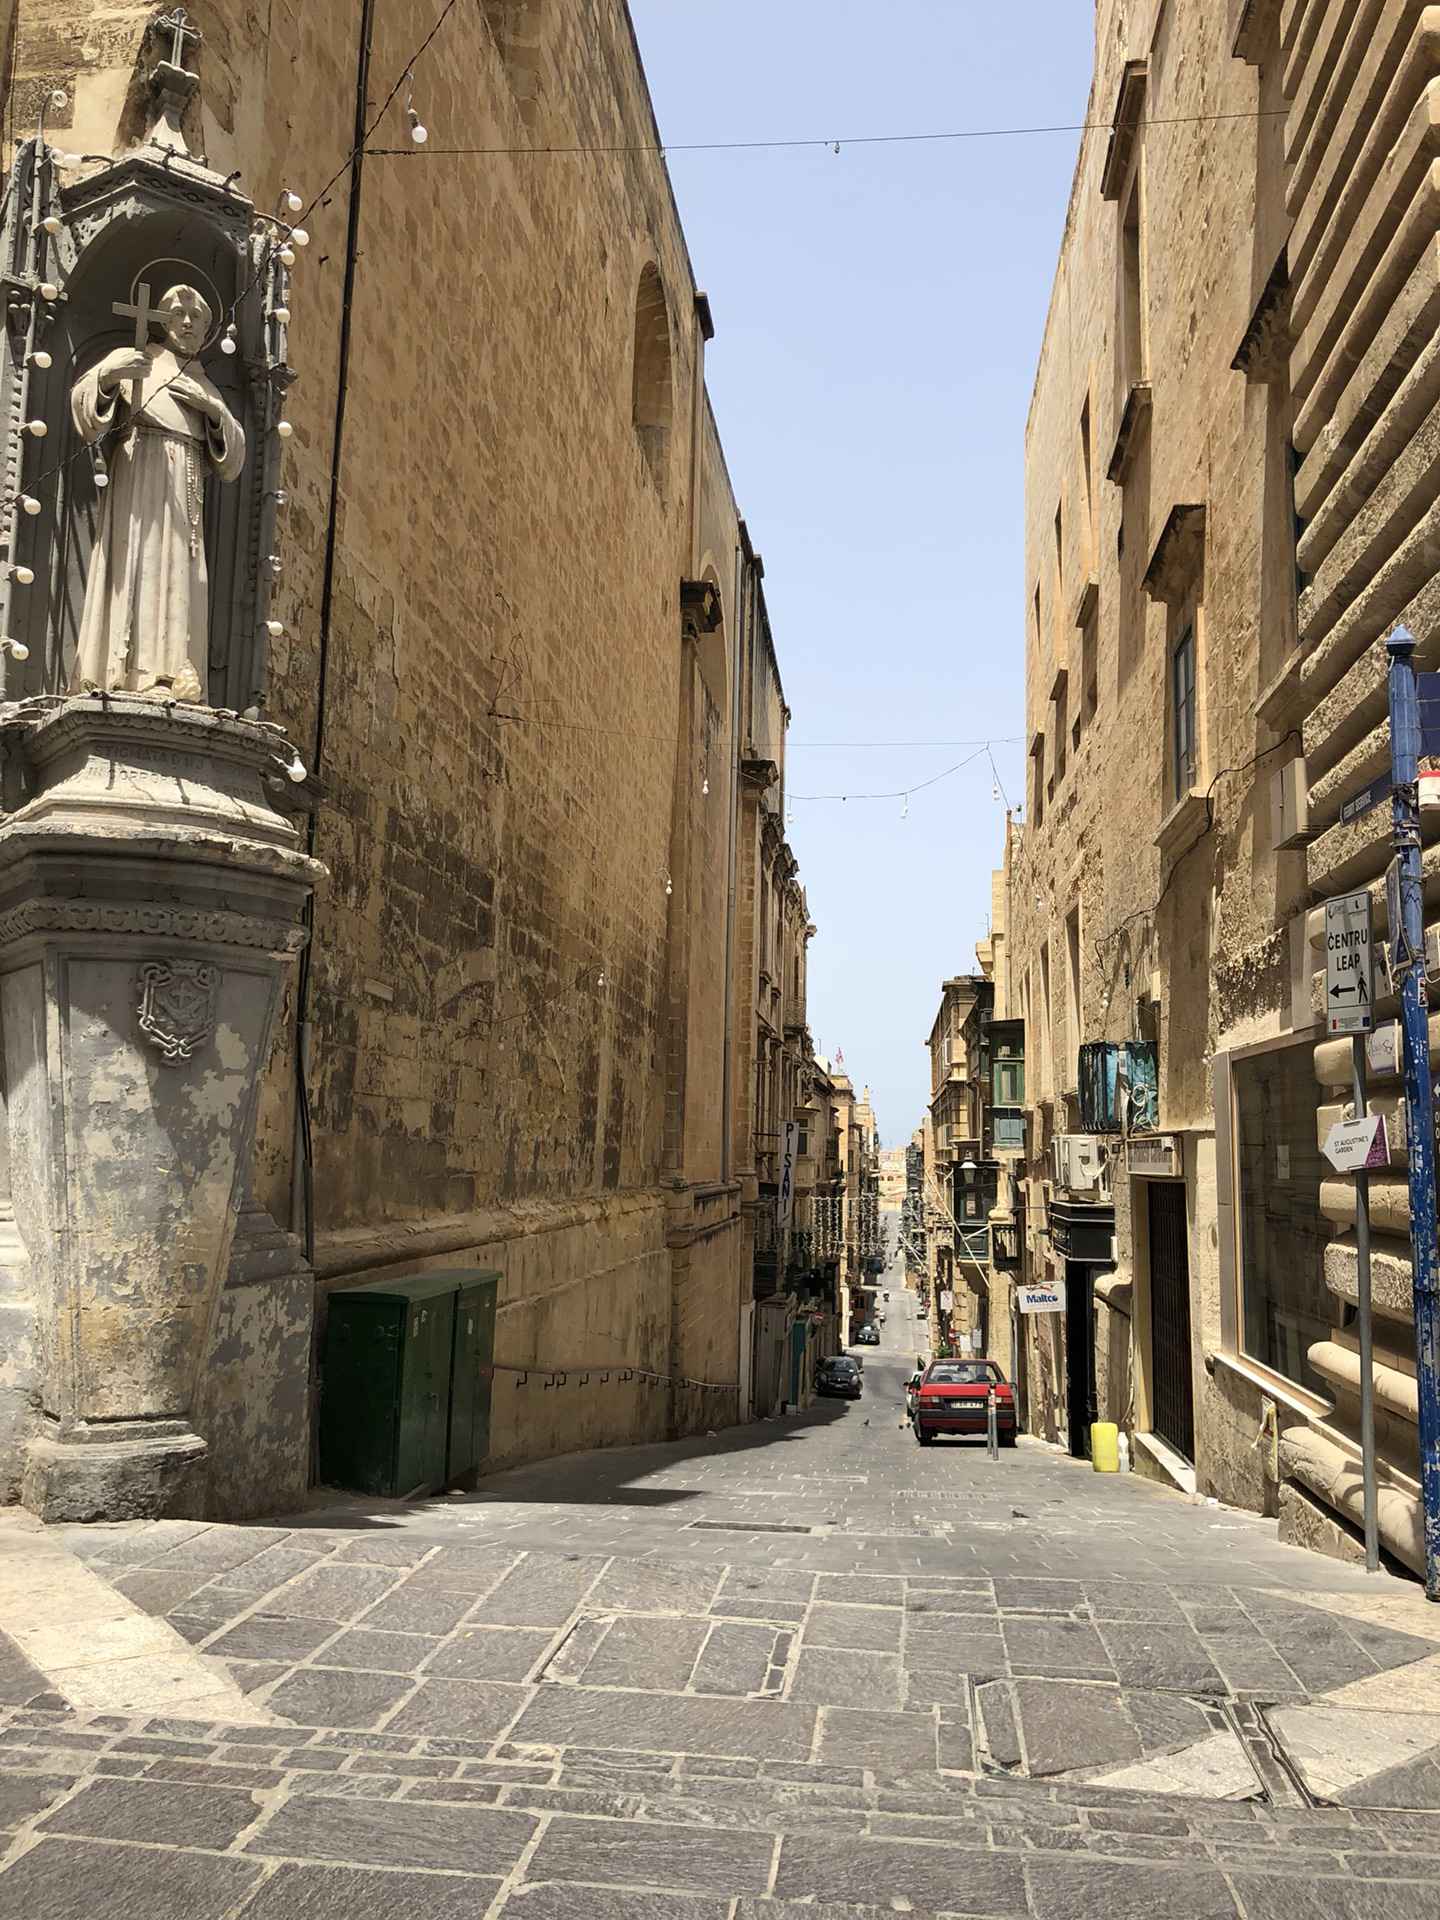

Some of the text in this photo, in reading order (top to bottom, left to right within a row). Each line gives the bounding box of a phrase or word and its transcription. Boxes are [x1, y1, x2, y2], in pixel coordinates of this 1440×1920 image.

[1336, 953, 1360, 971] LEAP
[782, 1123, 794, 1214] PISANI
[1026, 1294, 1058, 1304] Maltco
